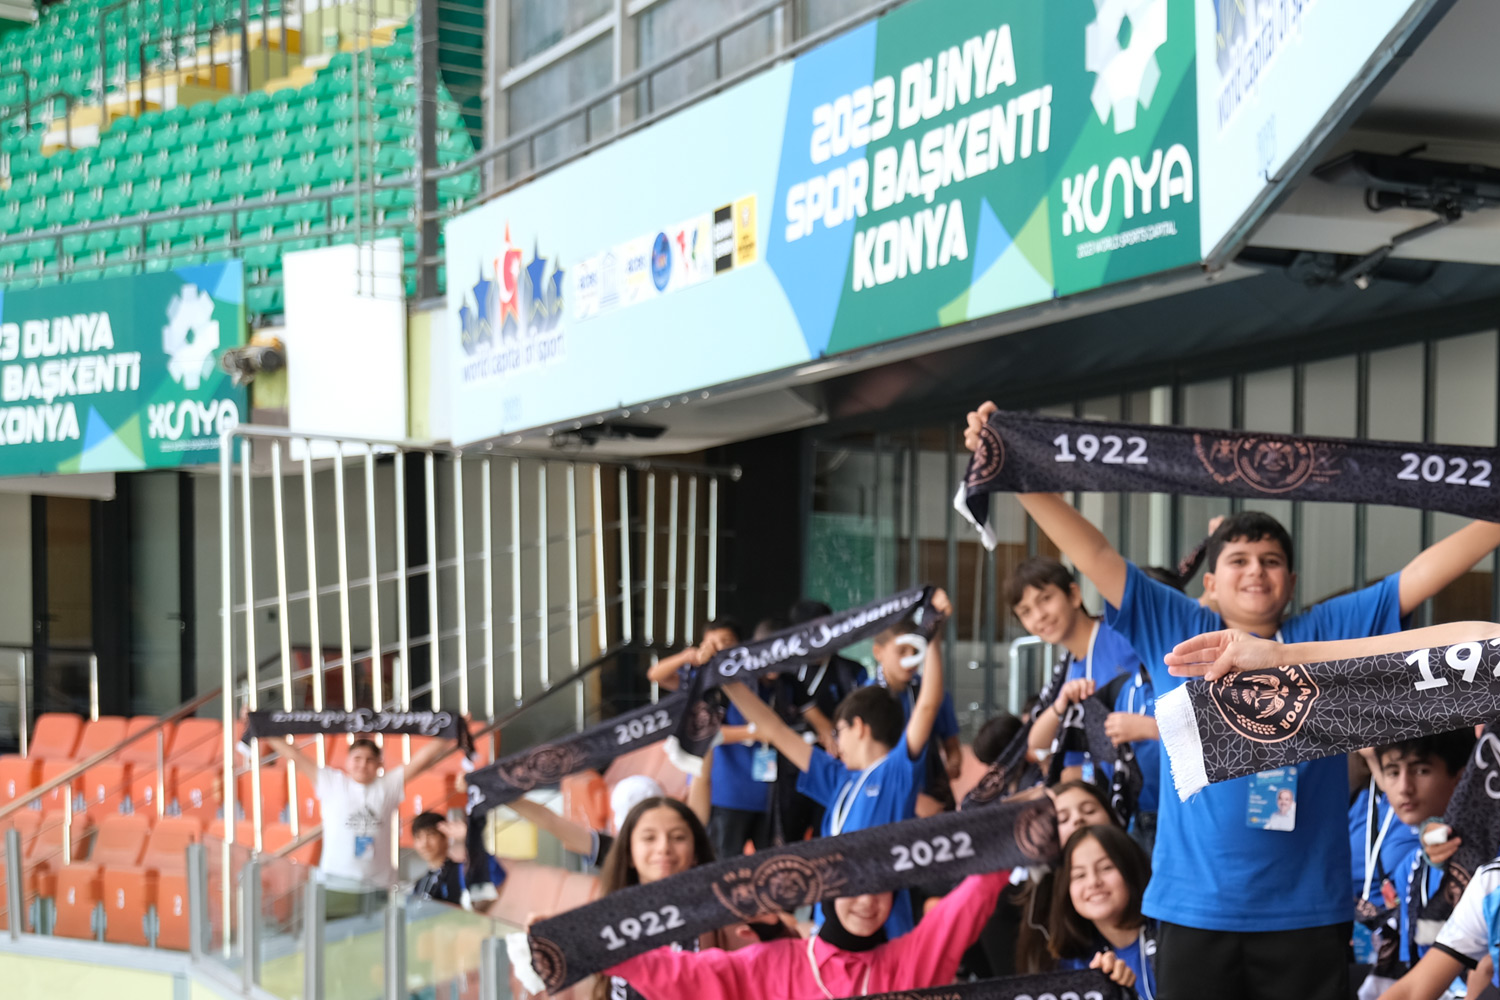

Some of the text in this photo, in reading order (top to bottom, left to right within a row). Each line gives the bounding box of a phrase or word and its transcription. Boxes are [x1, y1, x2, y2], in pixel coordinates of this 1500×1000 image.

[810, 23, 1017, 165] 2023 DÜNYA
[785, 84, 1053, 243] SPOR BAŞKENTİ
[852, 199, 968, 292] KONYA
[3, 352, 141, 404] BAŞKENTİ
[0, 402, 80, 446] ONYA
[1053, 434, 1149, 464] 1922
[1397, 452, 1492, 488] 2022
[1279, 665, 1311, 730] NYASPOR
[614, 710, 672, 745] 2022
[890, 831, 975, 872] 2022
[600, 904, 685, 950] 1922
